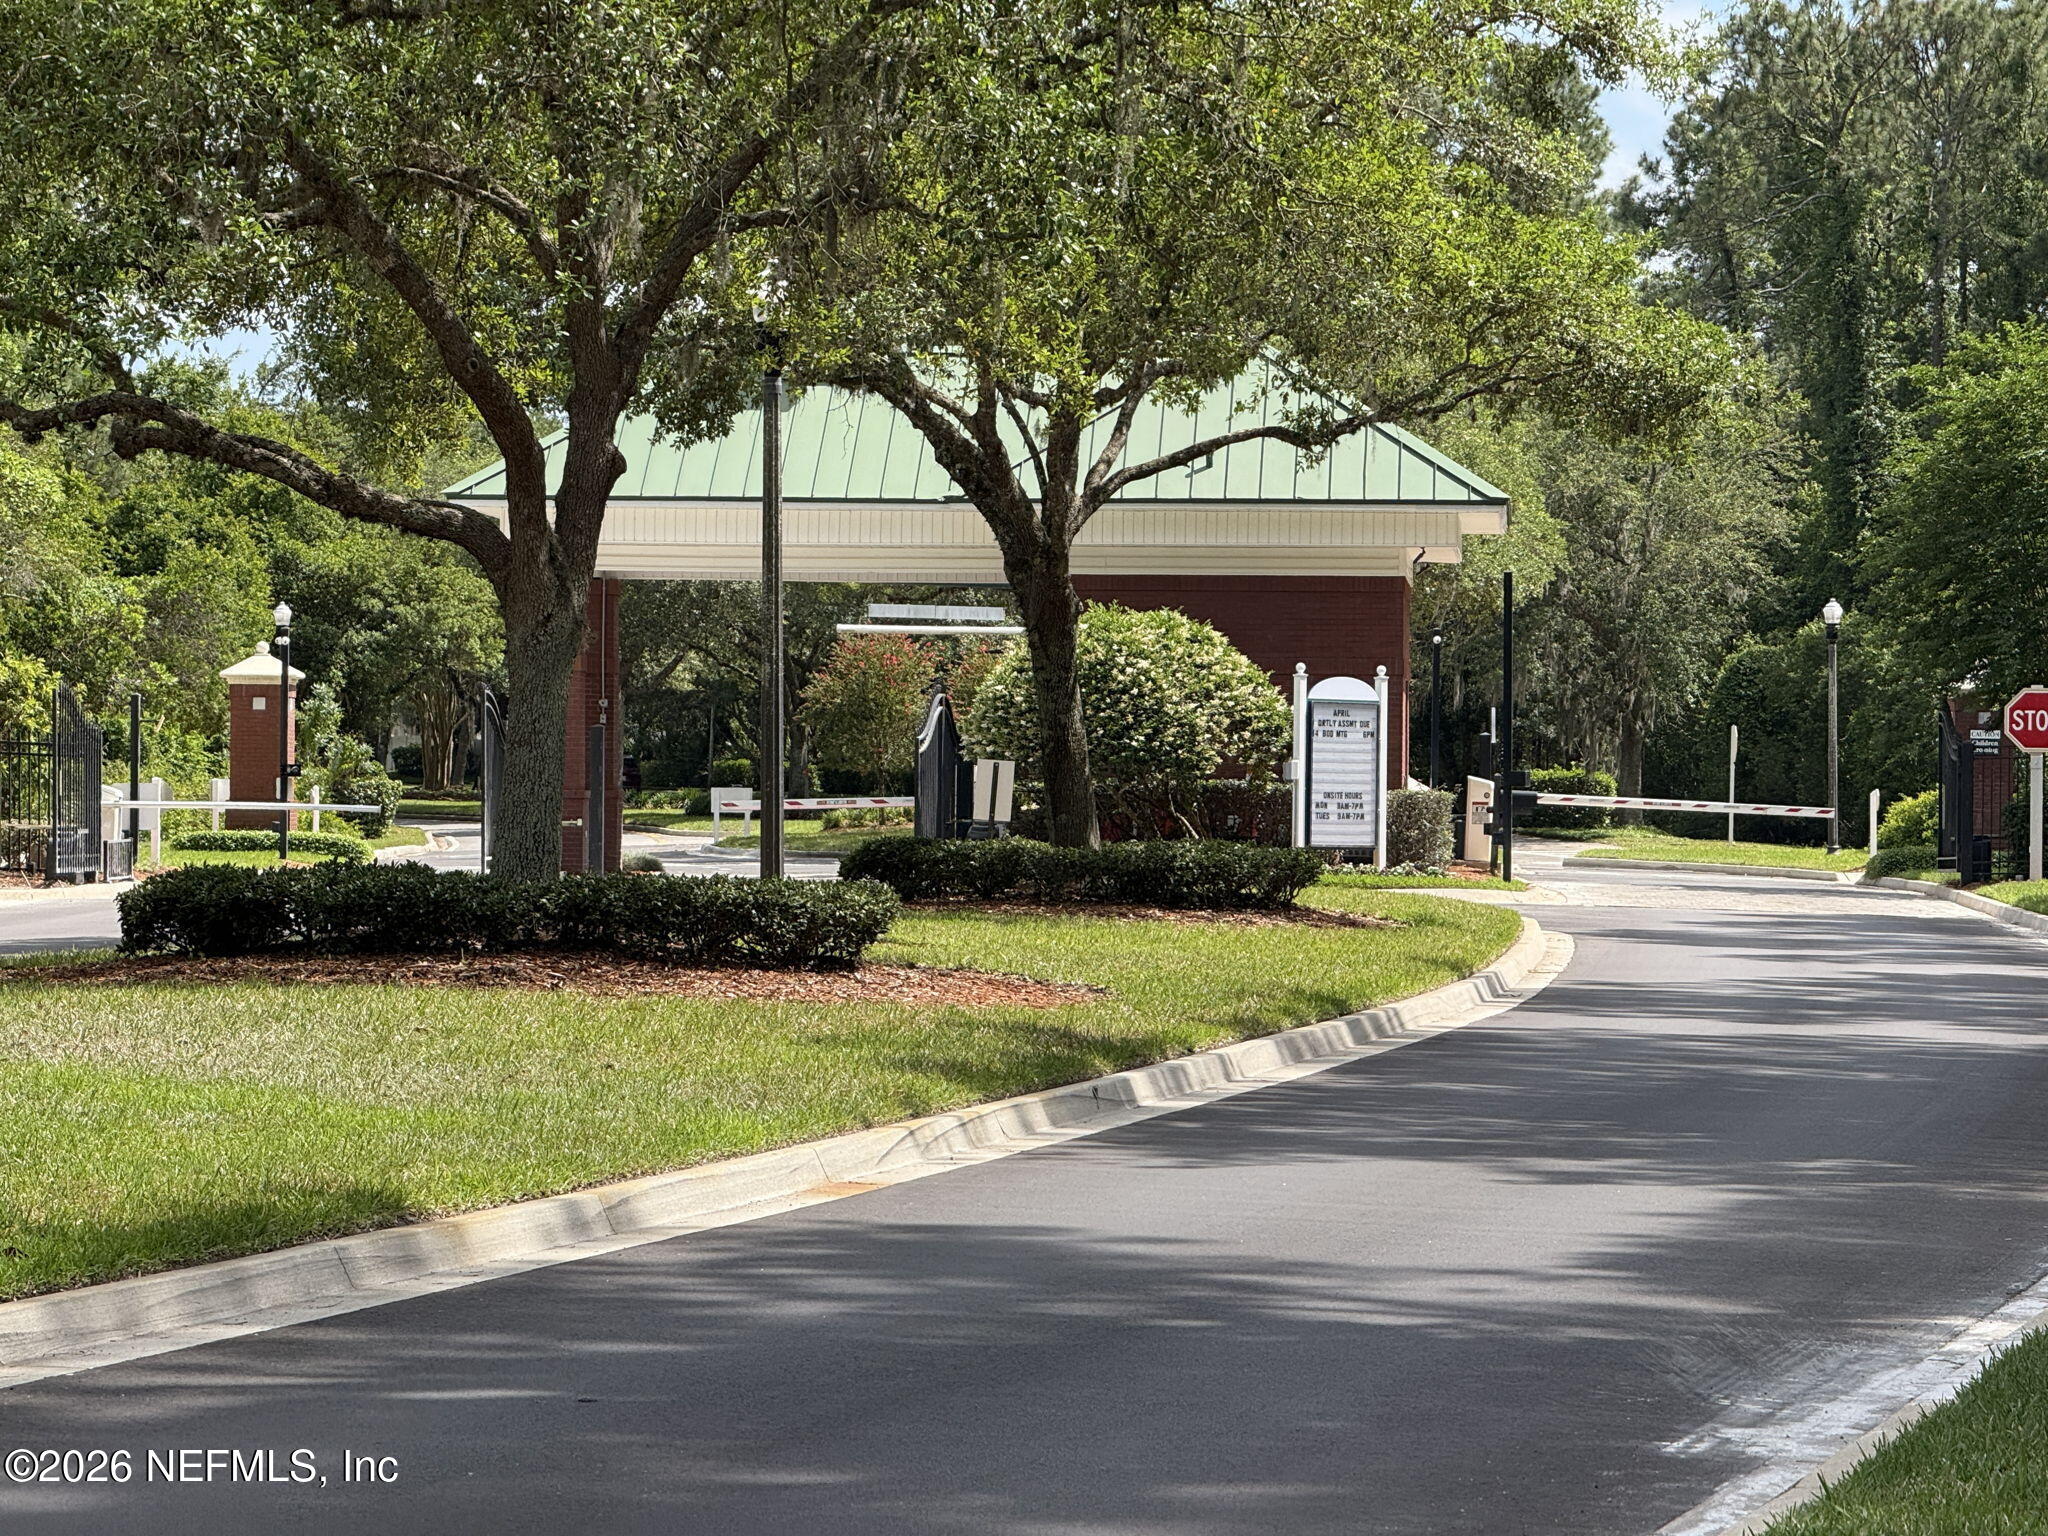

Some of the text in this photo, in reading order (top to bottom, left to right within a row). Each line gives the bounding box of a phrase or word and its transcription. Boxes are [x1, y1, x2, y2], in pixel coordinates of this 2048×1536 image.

[1333, 709, 1351, 717] APRIL
[1338, 720, 1357, 728] ASSMT
[1336, 730, 1348, 738] MTG
[1362, 730, 1375, 738] 6PM
[1323, 791, 1363, 800] ONSITE HOURS
[1315, 801, 1328, 809] MON
[1315, 812, 1330, 820] TUES
